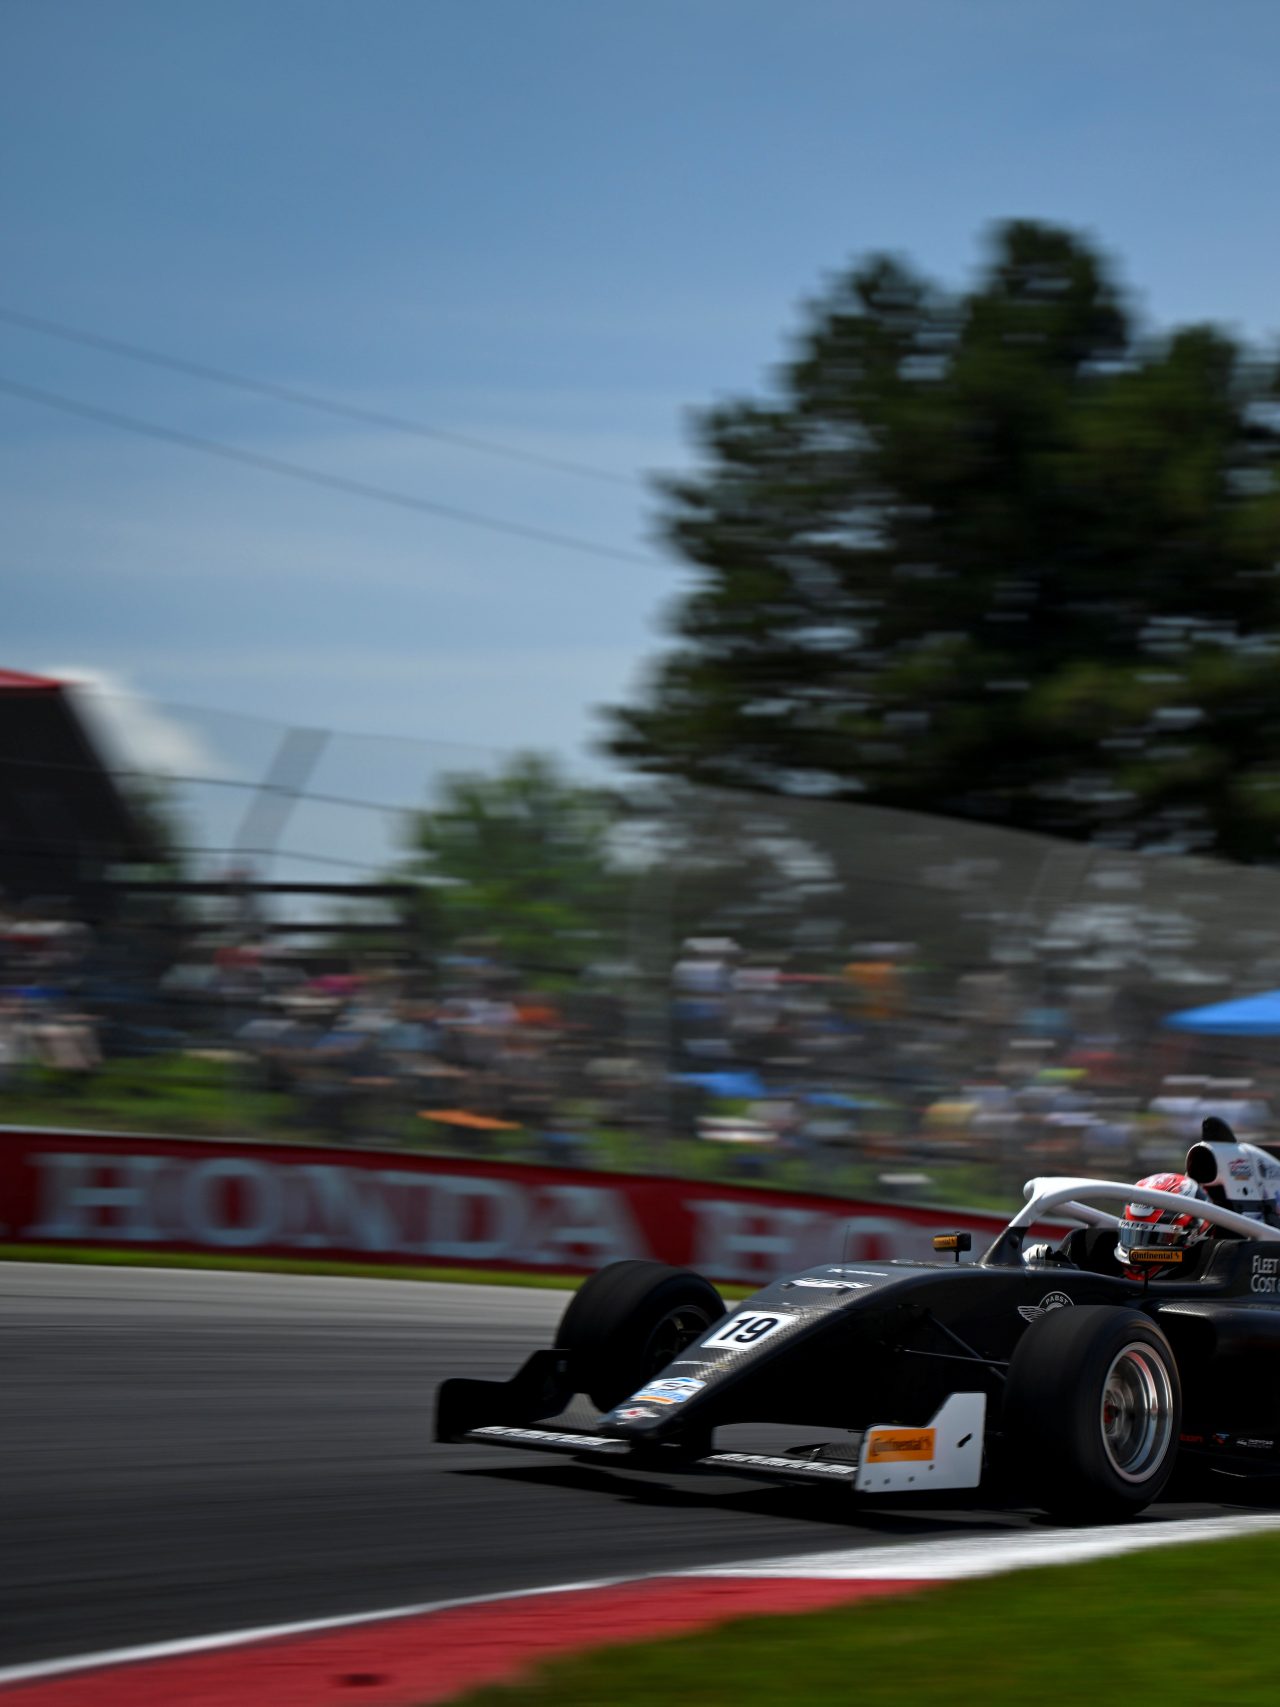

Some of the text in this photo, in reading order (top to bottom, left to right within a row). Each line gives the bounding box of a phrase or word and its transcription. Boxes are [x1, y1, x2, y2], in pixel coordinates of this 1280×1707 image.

[22, 1152, 658, 1269] HONDA
[1044, 1294, 1069, 1305] PABST
[718, 1316, 779, 1343] 19
